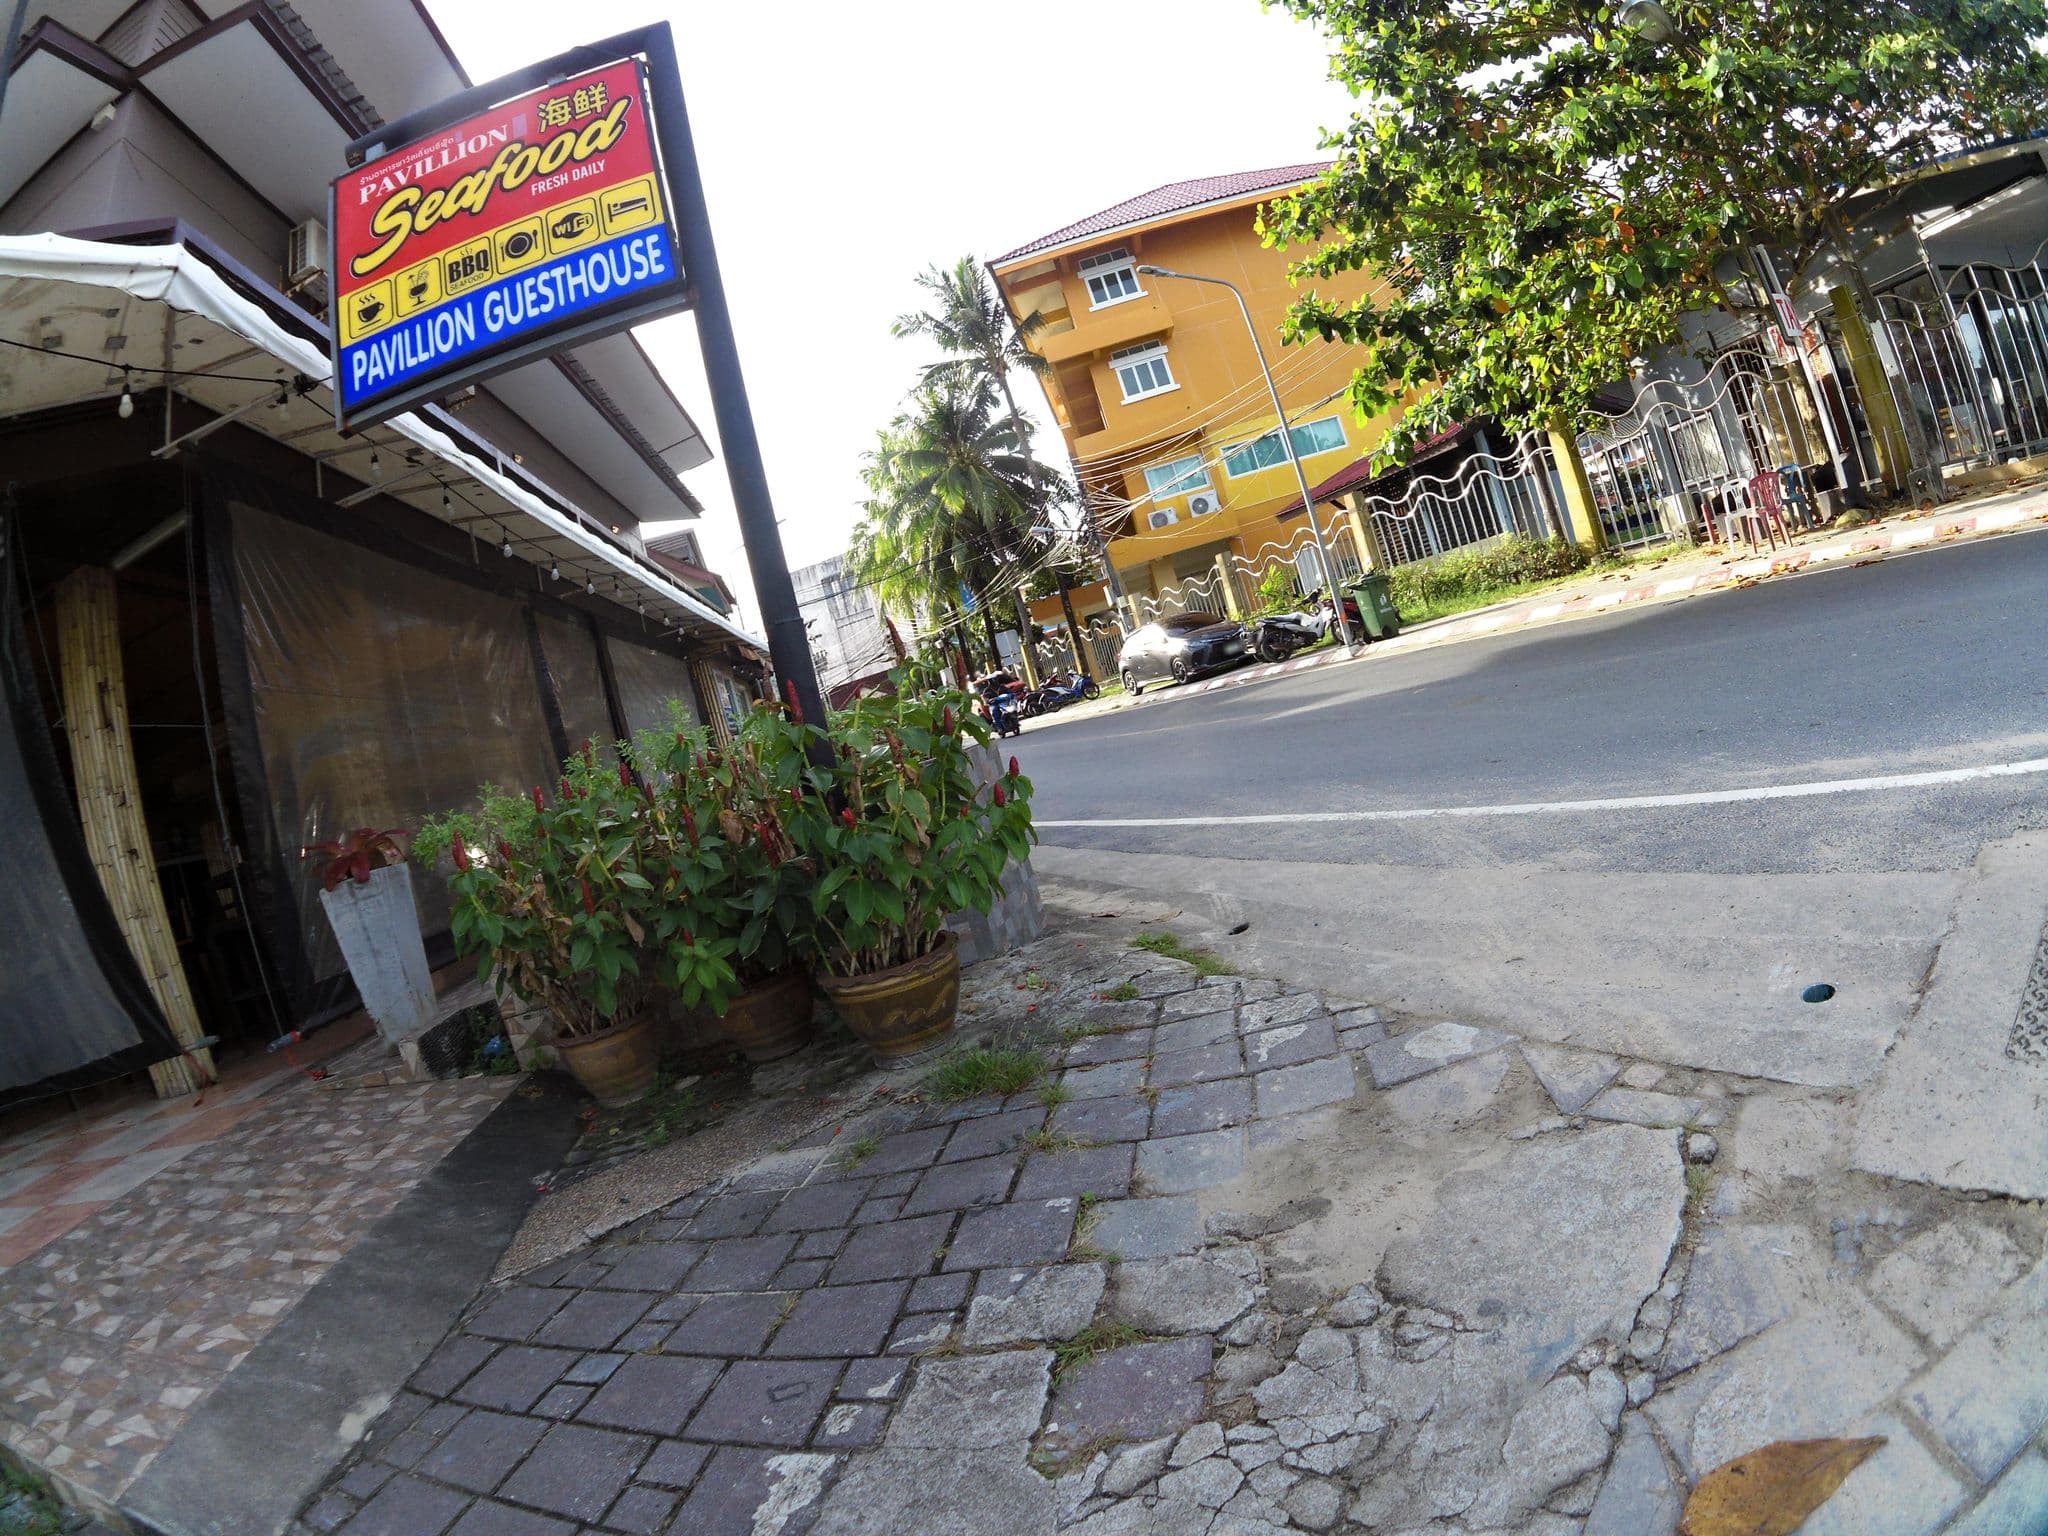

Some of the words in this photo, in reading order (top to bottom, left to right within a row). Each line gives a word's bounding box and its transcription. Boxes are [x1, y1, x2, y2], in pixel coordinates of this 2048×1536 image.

[351, 97, 631, 278] Seafood
[359, 124, 508, 205] PAVILLION
[531, 174, 569, 196] FRESH
[572, 160, 606, 181] DAILY
[448, 249, 489, 284] BBQ
[450, 273, 485, 291] SEAFOOD
[353, 302, 475, 391] PAVILLION
[483, 234, 666, 333] GUESTHOUSE
